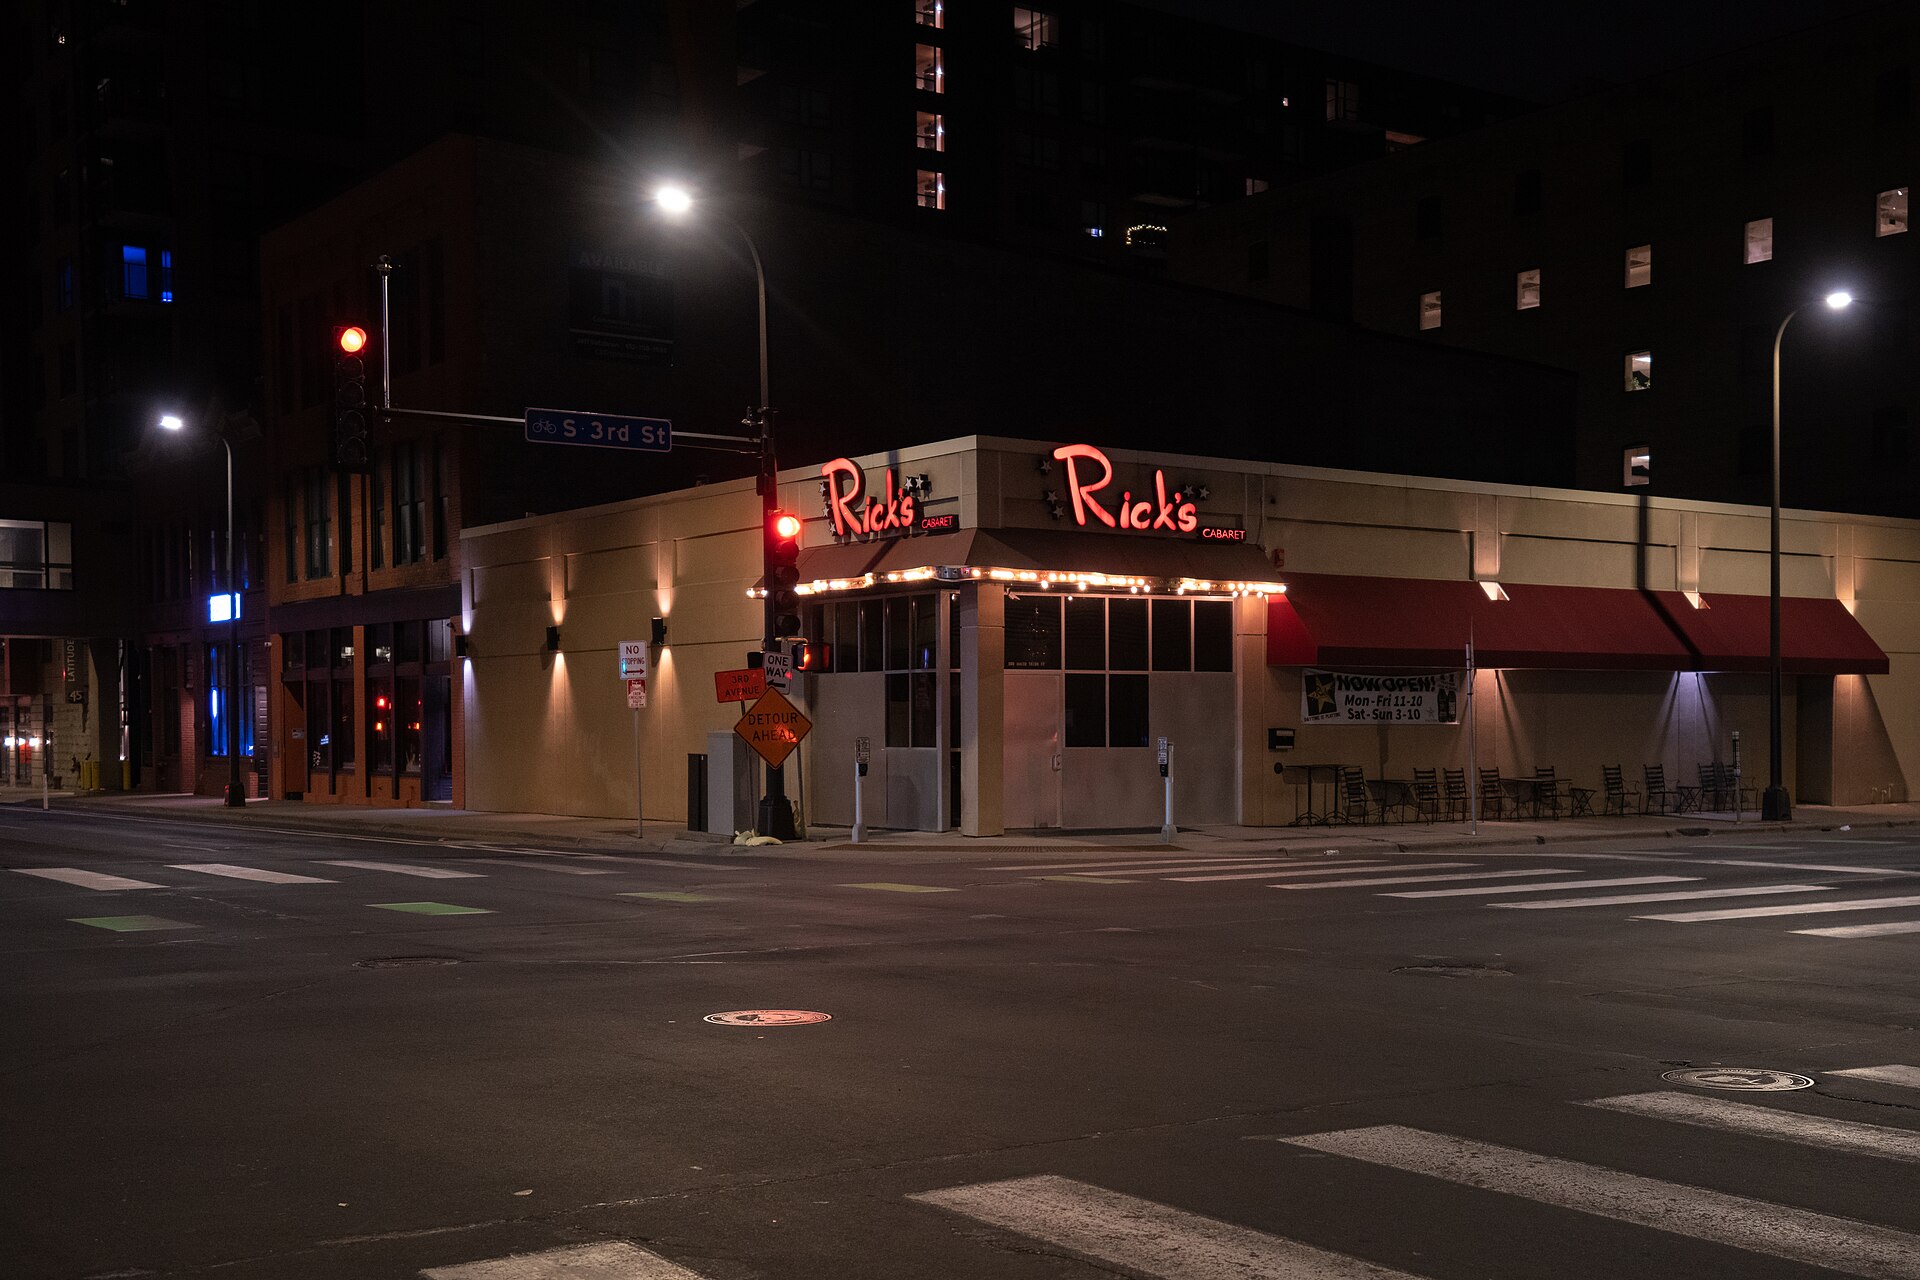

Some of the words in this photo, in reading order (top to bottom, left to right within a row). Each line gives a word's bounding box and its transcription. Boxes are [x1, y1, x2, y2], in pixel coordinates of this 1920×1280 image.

[562, 419, 577, 438] S
[590, 420, 630, 442] 3rd
[641, 425, 666, 445] St
[1053, 443, 1198, 533] Rick's
[821, 457, 916, 536] Rick's
[921, 515, 954, 530] CABARET
[1202, 528, 1246, 541] CABARET
[625, 645, 640, 655] NO
[67, 640, 75, 682] LATITUDE
[621, 656, 645, 665] STOPPING
[767, 655, 789, 667] ONE
[766, 666, 788, 678] WAY
[731, 674, 750, 684] 3RD
[1337, 675, 1380, 692] NOW
[1382, 676, 1436, 693] OPEN!
[70, 690, 83, 702] 45
[725, 686, 760, 697] AVENUE
[1393, 695, 1423, 707] 11-10
[748, 712, 798, 726] DETOUR
[1395, 708, 1421, 720] 3-10
[752, 729, 797, 742] AHEAD
